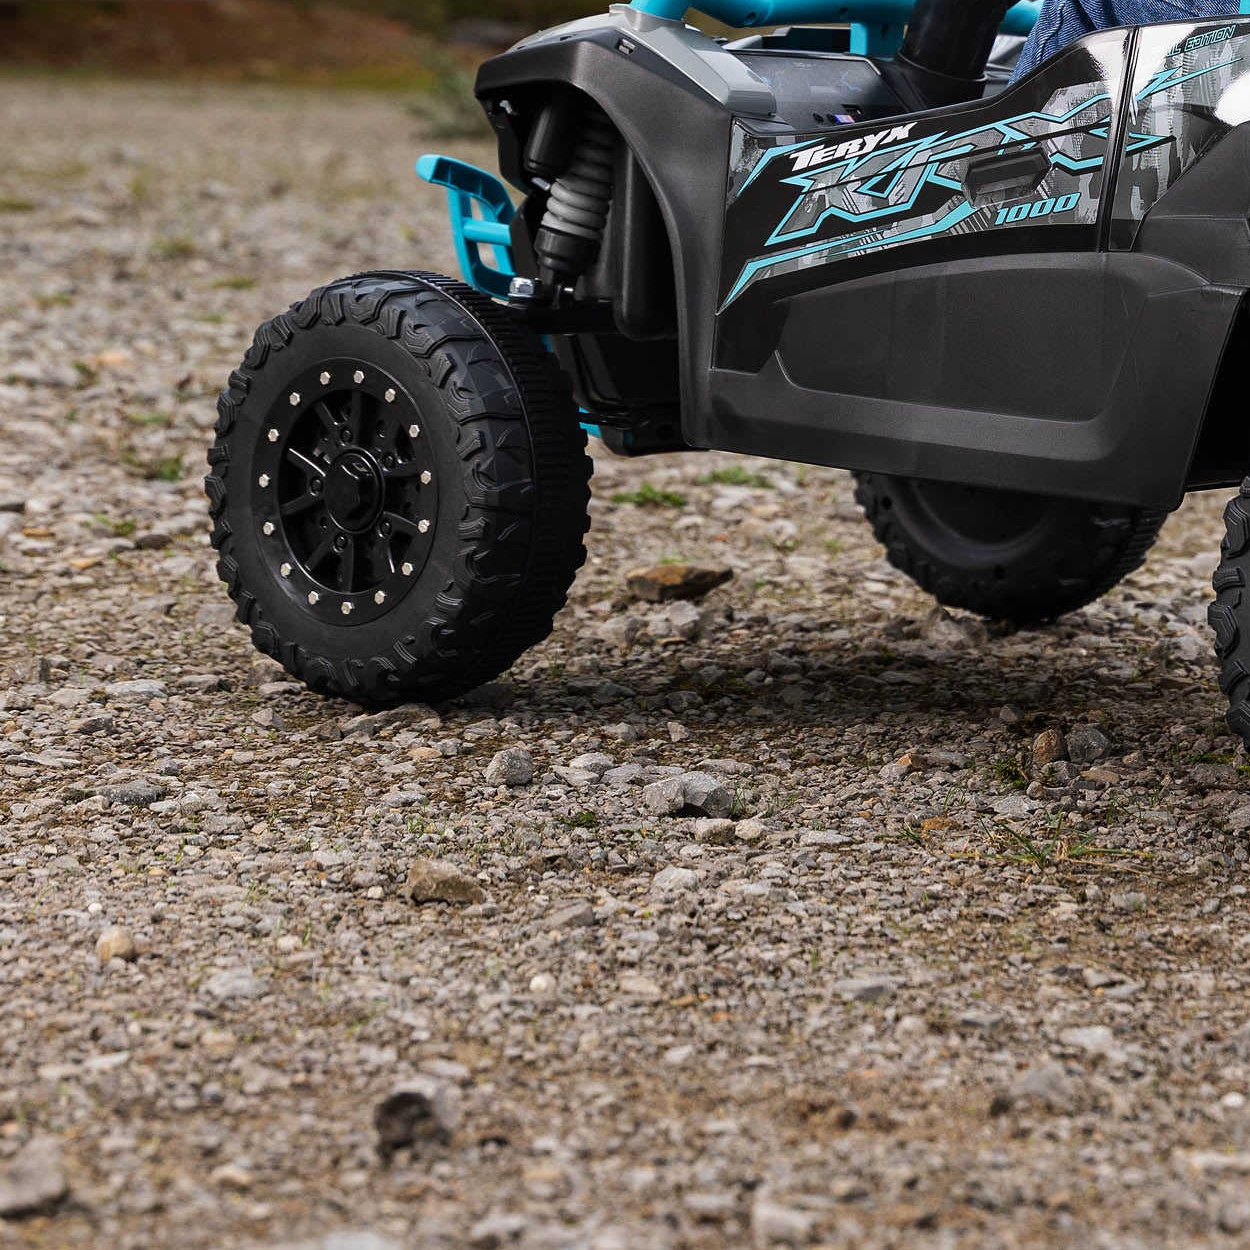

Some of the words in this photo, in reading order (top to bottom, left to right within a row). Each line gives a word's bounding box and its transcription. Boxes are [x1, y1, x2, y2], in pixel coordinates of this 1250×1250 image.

[1184, 25, 1236, 52] EDITION
[789, 121, 918, 172] TERYX
[994, 192, 1081, 225] 1000
